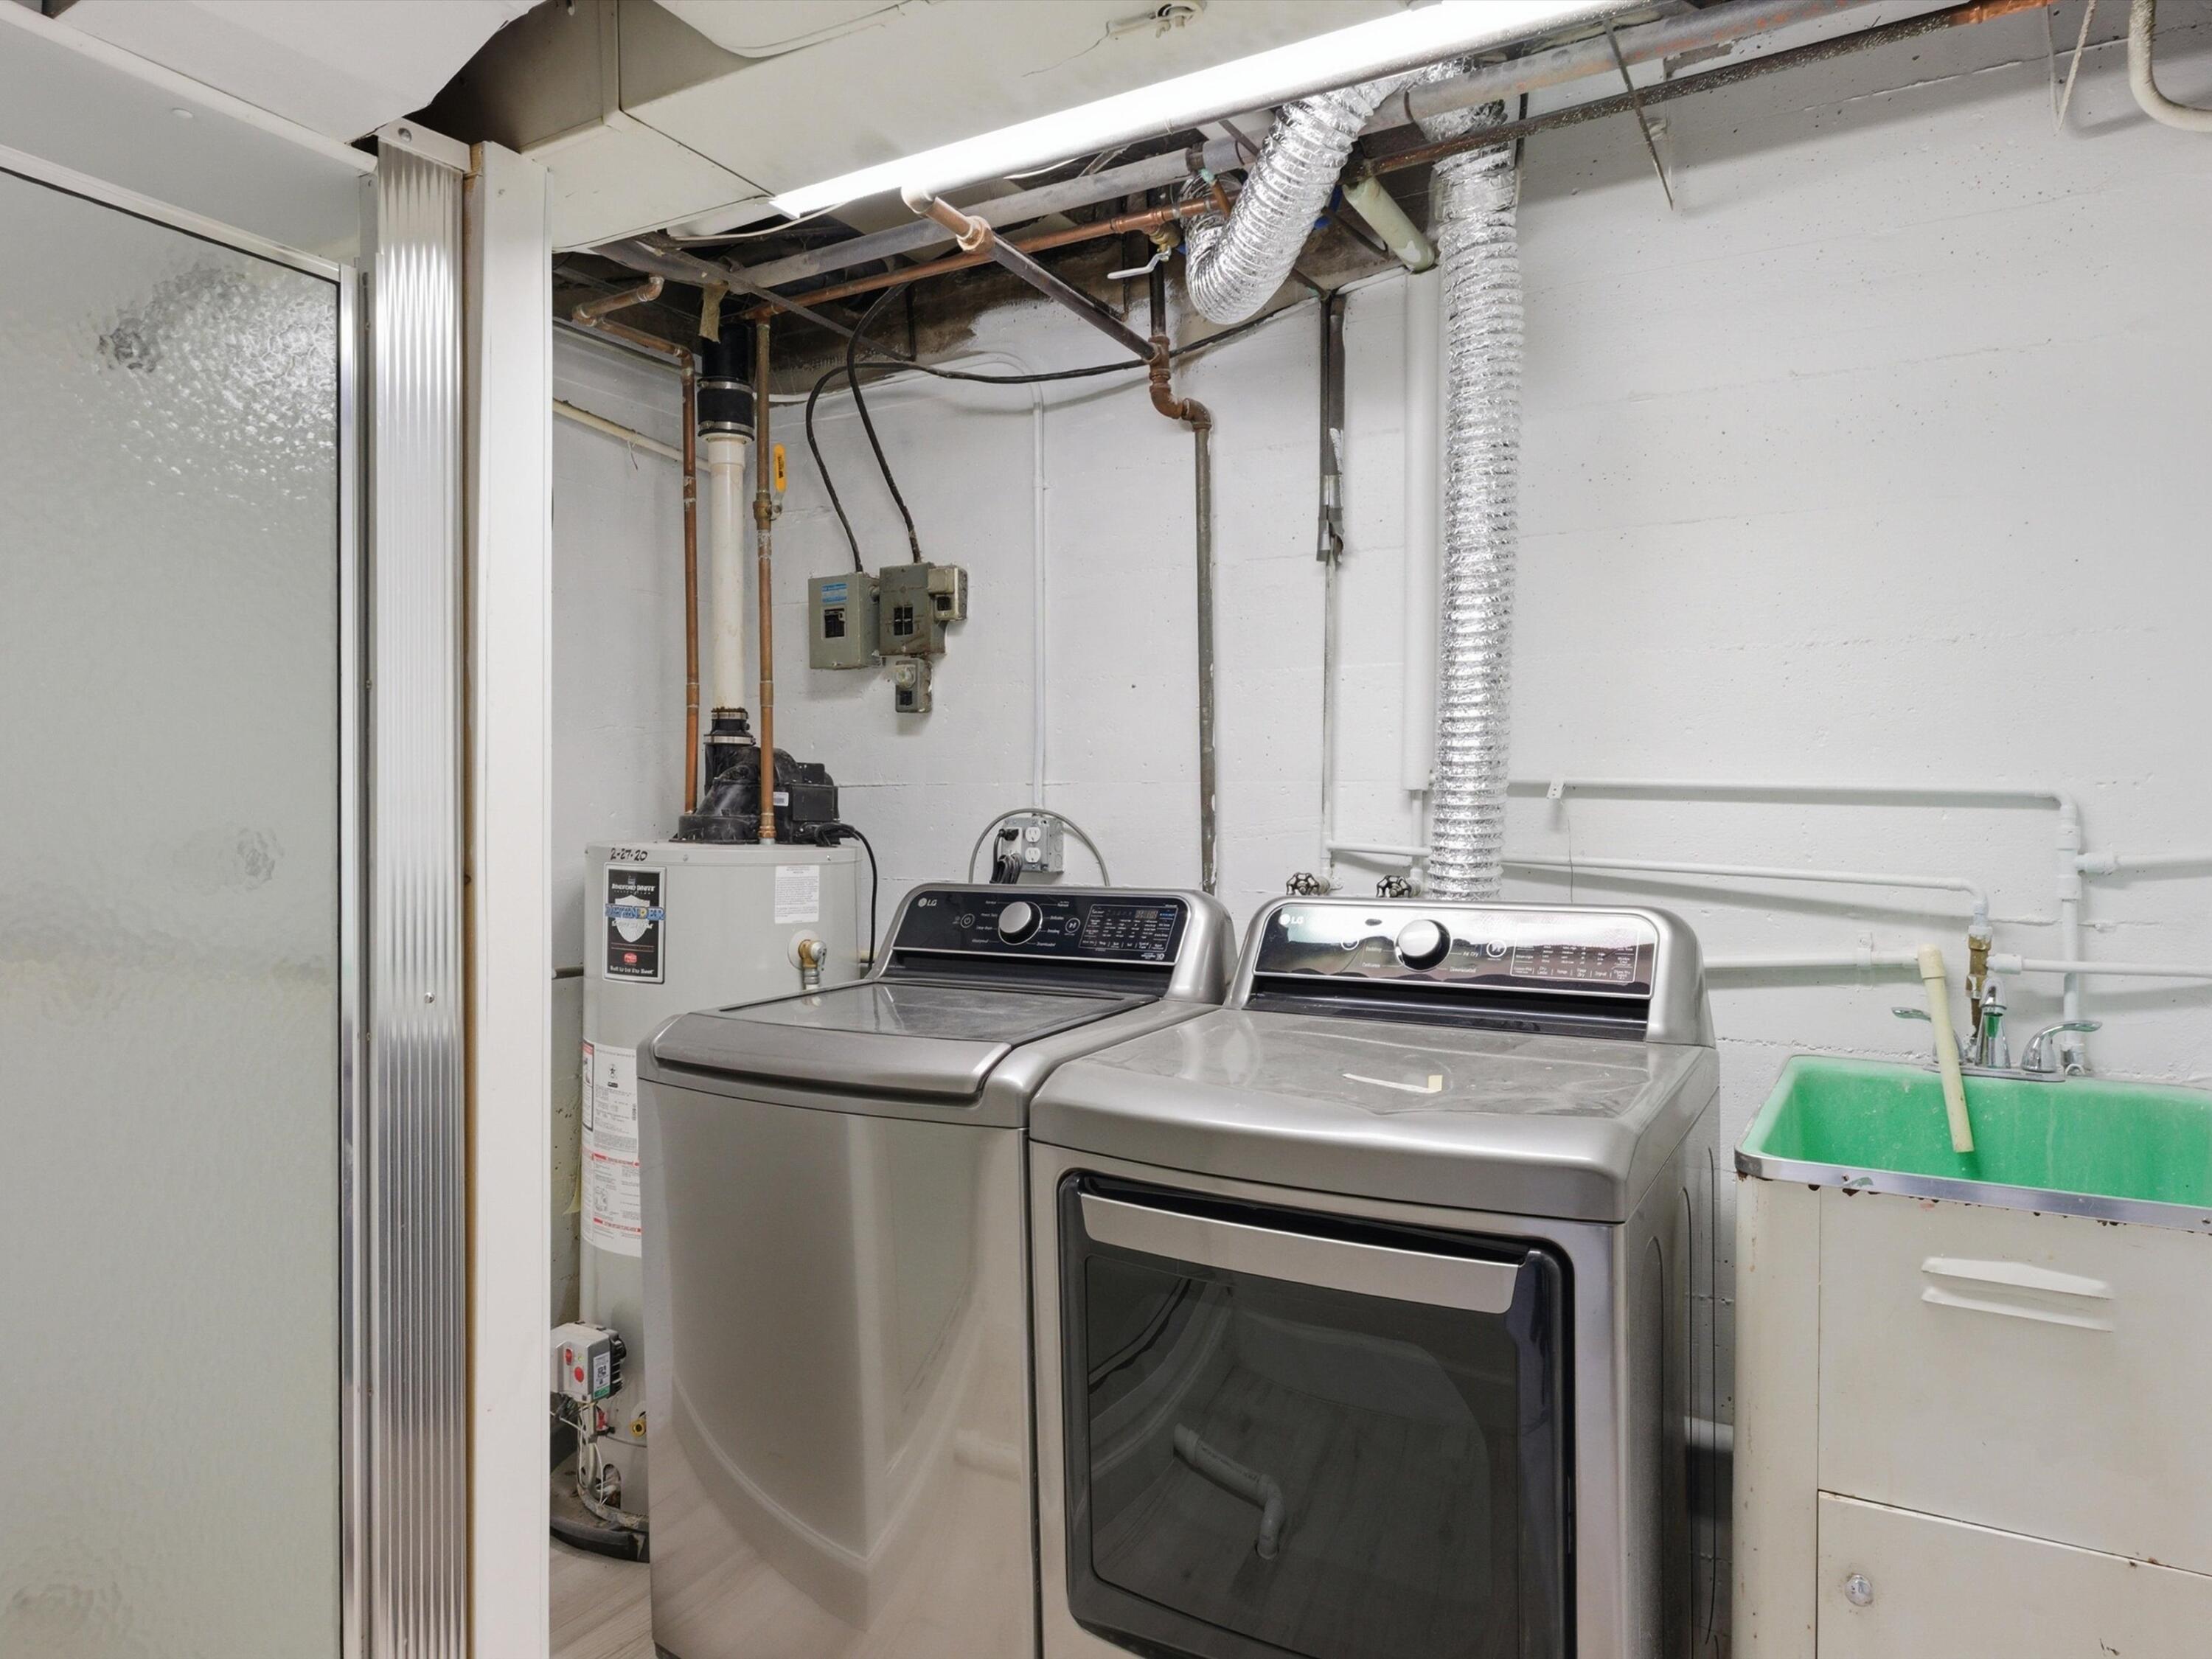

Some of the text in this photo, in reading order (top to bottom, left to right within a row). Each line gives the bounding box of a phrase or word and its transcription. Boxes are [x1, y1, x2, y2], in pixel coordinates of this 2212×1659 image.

[927, 899, 938, 907] LG
[605, 905, 665, 919] DEFENDER
[1290, 916, 1304, 925] LG
